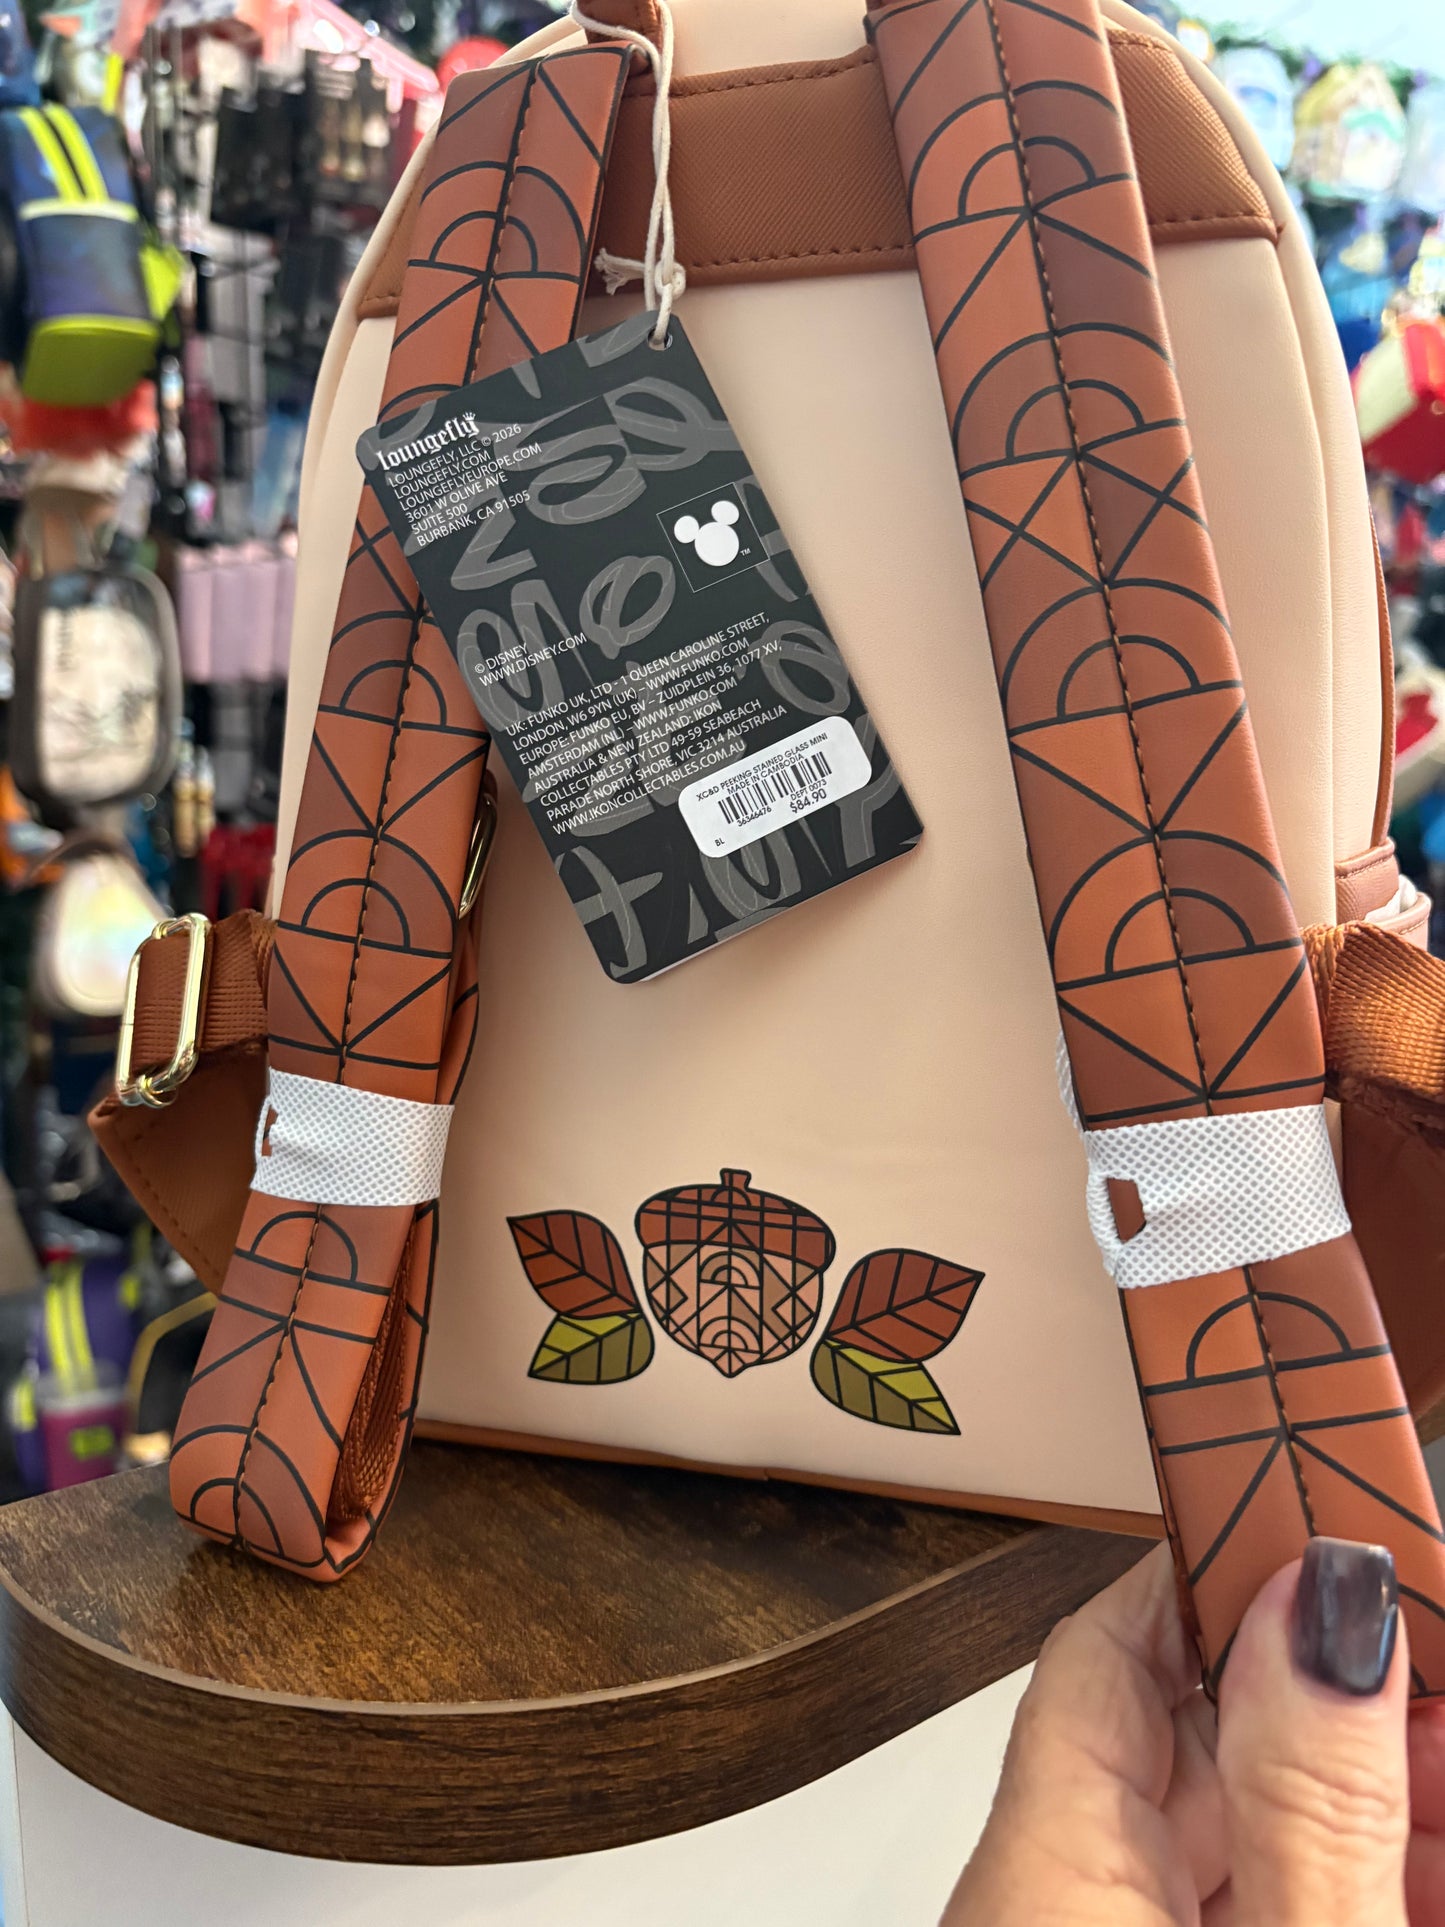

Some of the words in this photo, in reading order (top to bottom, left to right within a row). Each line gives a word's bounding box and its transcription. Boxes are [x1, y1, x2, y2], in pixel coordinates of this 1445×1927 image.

[375, 412, 480, 470] loungefly
[387, 450, 458, 487] LOUNGEFLY,
[458, 440, 481, 457] LLC
[492, 423, 521, 443] 2026
[394, 450, 491, 499] LOUNGEFLY.COM
[399, 442, 542, 511] LOUNGEFLYEUROPE.COM
[405, 503, 434, 523] 3601
[434, 496, 447, 509] W
[449, 481, 484, 503] OLIVE
[485, 471, 507, 489] AVE
[411, 512, 446, 535] SUITE
[445, 503, 468, 520] 500
[416, 514, 476, 546] BURBANK,
[476, 506, 496, 519] CA
[494, 490, 530, 513] 91505
[478, 632, 587, 686] WWW.DISNEY.COM
[485, 642, 527, 669] DISNEY
[505, 720, 528, 736] UK:
[526, 701, 568, 727] FUNKO
[569, 692, 590, 708] UK,
[590, 682, 612, 699] LTD
[620, 675, 627, 685] 1
[629, 656, 669, 681] QUEEN
[669, 630, 726, 663] CAROLINE
[726, 612, 769, 638] STREET,
[512, 720, 568, 750] LONDON,
[566, 710, 587, 726] W6
[587, 698, 612, 717] 9YN
[612, 686, 637, 706] (UK)
[645, 637, 749, 690] WWW.FUNKO.COM
[519, 736, 570, 765] EUROPE:
[569, 717, 610, 743] FUNKO
[610, 708, 631, 724] EU,
[630, 699, 645, 715] BV
[655, 668, 716, 704] ZUIDPLEIN
[716, 662, 735, 676] 36,
[735, 647, 760, 667] 1077
[761, 639, 782, 655] XV,
[528, 738, 601, 779] AMSTERDAM
[600, 727, 624, 746] (NL)
[633, 676, 737, 730] WWW.FUNKO.COM
[534, 758, 597, 793] AUSTRALIA
[597, 753, 608, 764] &
[607, 739, 634, 760] NEW
[635, 715, 694, 747] ZEALAND:
[692, 700, 722, 720] IKON
[540, 761, 624, 806] COLLECTABLES
[624, 750, 646, 769] PTY
[647, 741, 669, 758] LTD
[671, 726, 702, 746] 49-59
[702, 699, 761, 733] SEABEACH
[546, 792, 594, 821] PARADE
[593, 774, 635, 800] NORTH
[635, 755, 677, 781] SHORE,
[675, 745, 697, 761] VIC
[696, 733, 725, 753] 3214
[727, 705, 787, 740] AUSTRALIA
[552, 739, 745, 834] WWW.IKONCOLLECTABLES.COM.AU
[719, 769, 752, 790] PEEKING
[752, 754, 784, 774] STAINED
[784, 741, 809, 758] GLASS
[809, 732, 828, 746] MINI
[726, 778, 751, 794] MADE
[750, 773, 760, 783] IN
[760, 753, 804, 778] CAMBODIA
[714, 837, 725, 847] BL
[789, 788, 827, 814] $84.90
[736, 805, 772, 827] 36346476
[790, 787, 808, 801] DEPT
[808, 778, 827, 792] 0073
